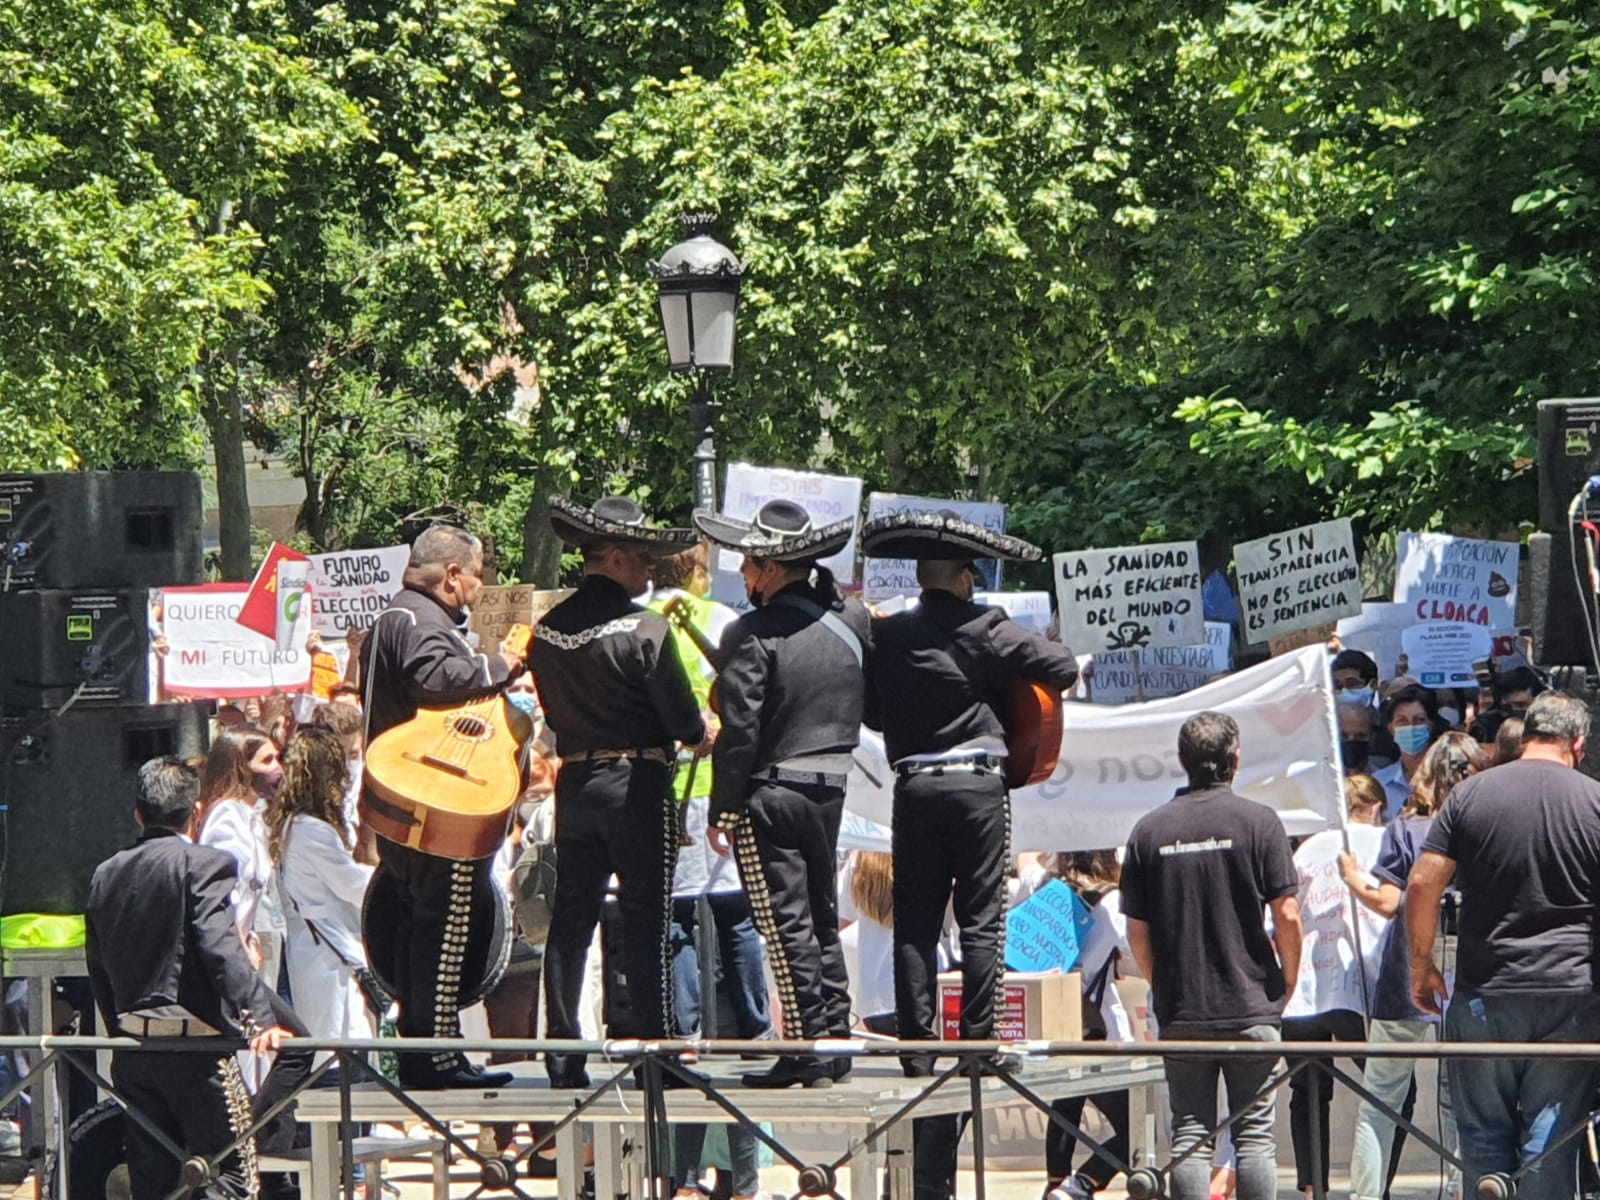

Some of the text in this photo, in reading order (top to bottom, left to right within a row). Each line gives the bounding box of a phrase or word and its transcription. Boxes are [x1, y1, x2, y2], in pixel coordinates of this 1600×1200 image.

[1268, 527, 1314, 561] SIN
[323, 555, 381, 576] FUTURO
[1063, 549, 1188, 579] LA SANIDAD
[1240, 546, 1349, 586] TRANSPARENCIA
[330, 571, 390, 588] SANIDAD
[1075, 573, 1199, 601] MÁS EFICIENTE
[1247, 593, 1268, 611] NO
[1297, 564, 1357, 594] ELECCIÓN
[1470, 585, 1480, 600] A
[168, 604, 240, 622] QUIERO
[1087, 599, 1191, 626] DEL MUNDO
[1273, 592, 1347, 623] SENTENCIA
[1417, 599, 1488, 626] CLOACA
[181, 650, 299, 665] MI FUTURO
